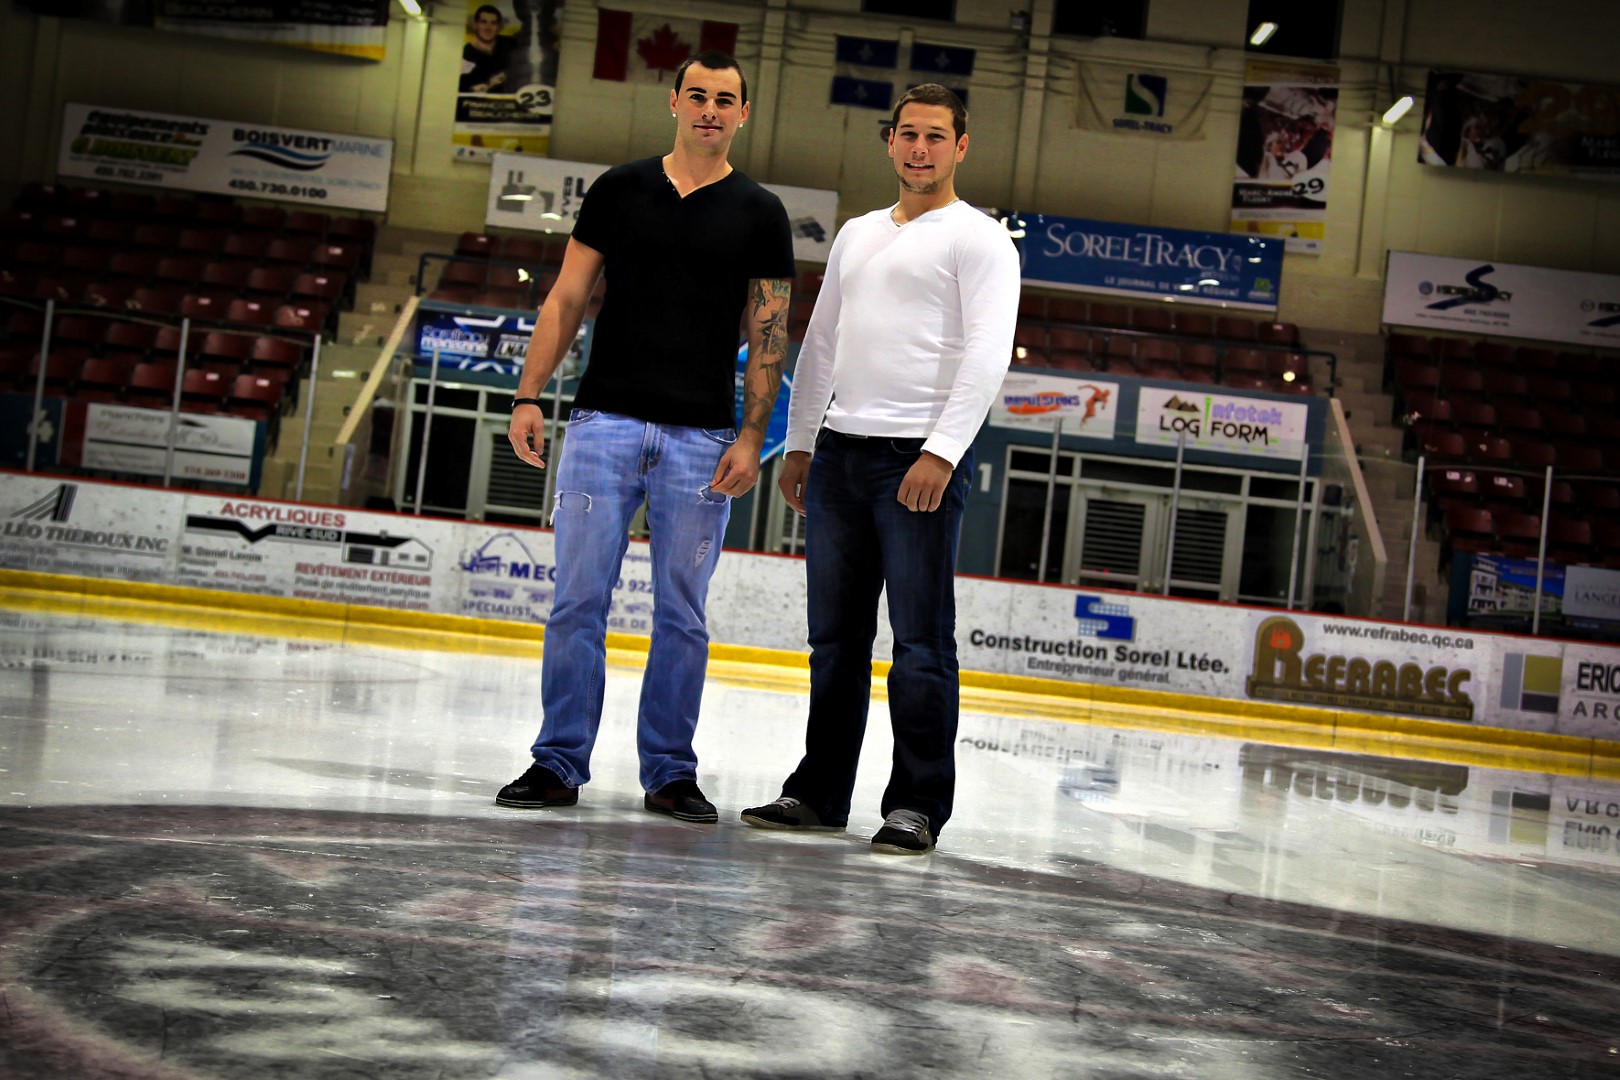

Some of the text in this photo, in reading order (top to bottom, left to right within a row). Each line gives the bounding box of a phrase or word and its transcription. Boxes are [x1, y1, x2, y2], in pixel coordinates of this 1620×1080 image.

[520, 89, 552, 109] 23
[232, 128, 385, 158] BOISVERT MARINE
[229, 179, 328, 199] 450.730.0100
[1293, 178, 1324, 195] 29
[1043, 223, 1234, 272] SOREL-TRACY
[1159, 415, 1200, 438] LOG
[1210, 420, 1269, 446] FORM
[978, 463, 992, 492] 1
[220, 501, 347, 528] ACRYLIQUES
[134, 534, 170, 552] INC
[275, 525, 338, 542] RIVE-SUD
[1322, 622, 1475, 650] www.refrabec.qc.ca
[970, 629, 1230, 675] Construction Sorel Ltée.
[1254, 615, 1473, 706] REFRABEC
[1027, 656, 1115, 678] Entrepreneur
